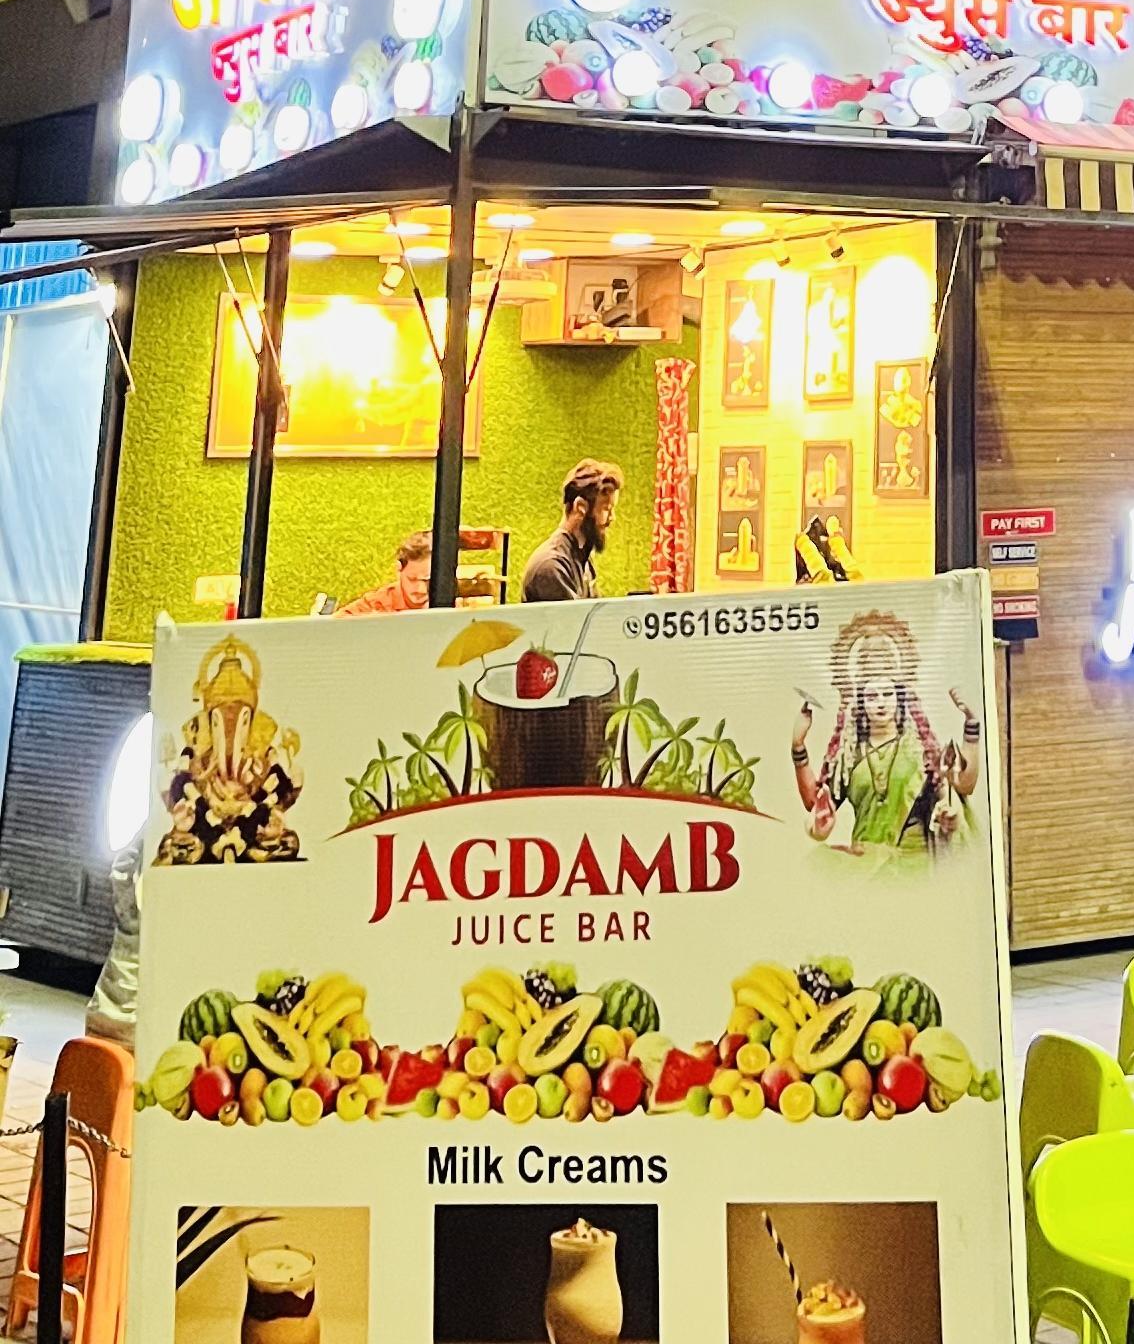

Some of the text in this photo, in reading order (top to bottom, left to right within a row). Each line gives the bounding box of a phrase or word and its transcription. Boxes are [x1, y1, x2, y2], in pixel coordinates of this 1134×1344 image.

[990, 516, 1047, 531] PAY FIRST
[644, 603, 820, 640] 9561635555
[367, 820, 741, 925] JAGDAMB
[451, 911, 652, 946] JUICE BAR
[427, 1146, 669, 1187] Milk Creams
